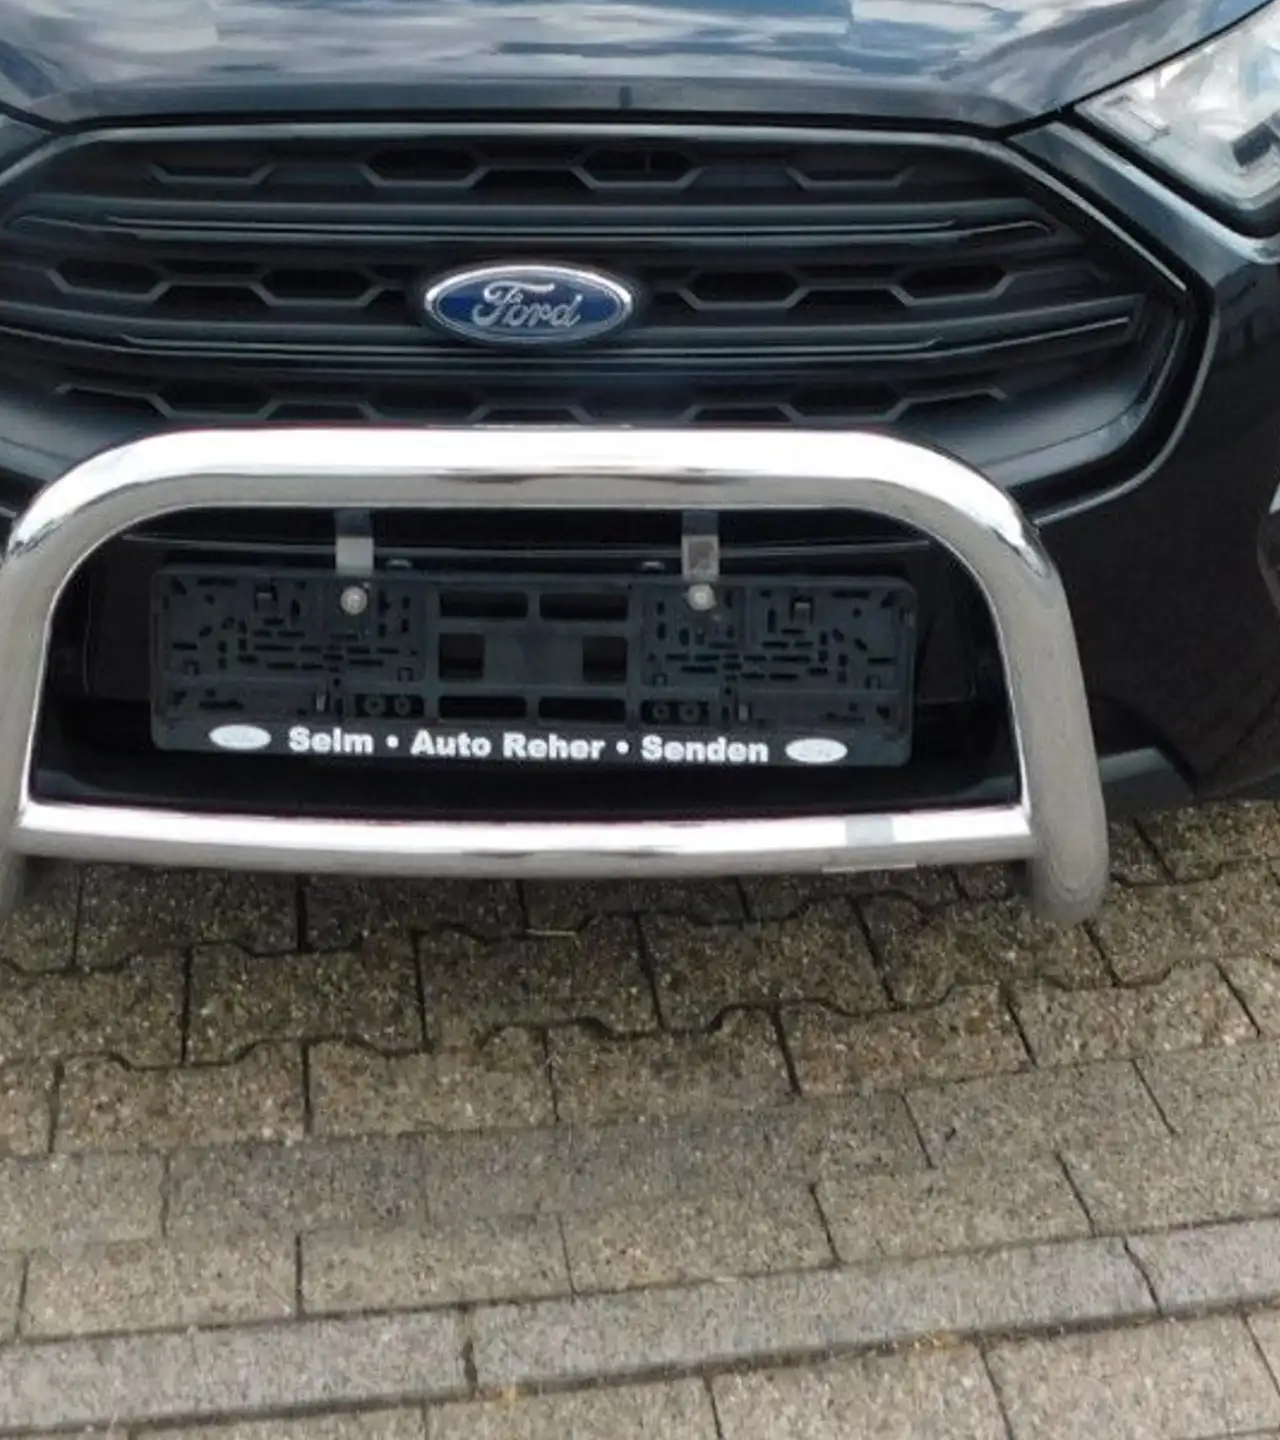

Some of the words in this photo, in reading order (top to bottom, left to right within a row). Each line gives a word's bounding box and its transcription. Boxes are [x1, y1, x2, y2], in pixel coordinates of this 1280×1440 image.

[470, 280, 584, 328] Ford
[410, 728, 492, 757] Auto
[502, 731, 606, 760] Reher
[641, 734, 769, 764] Senden
